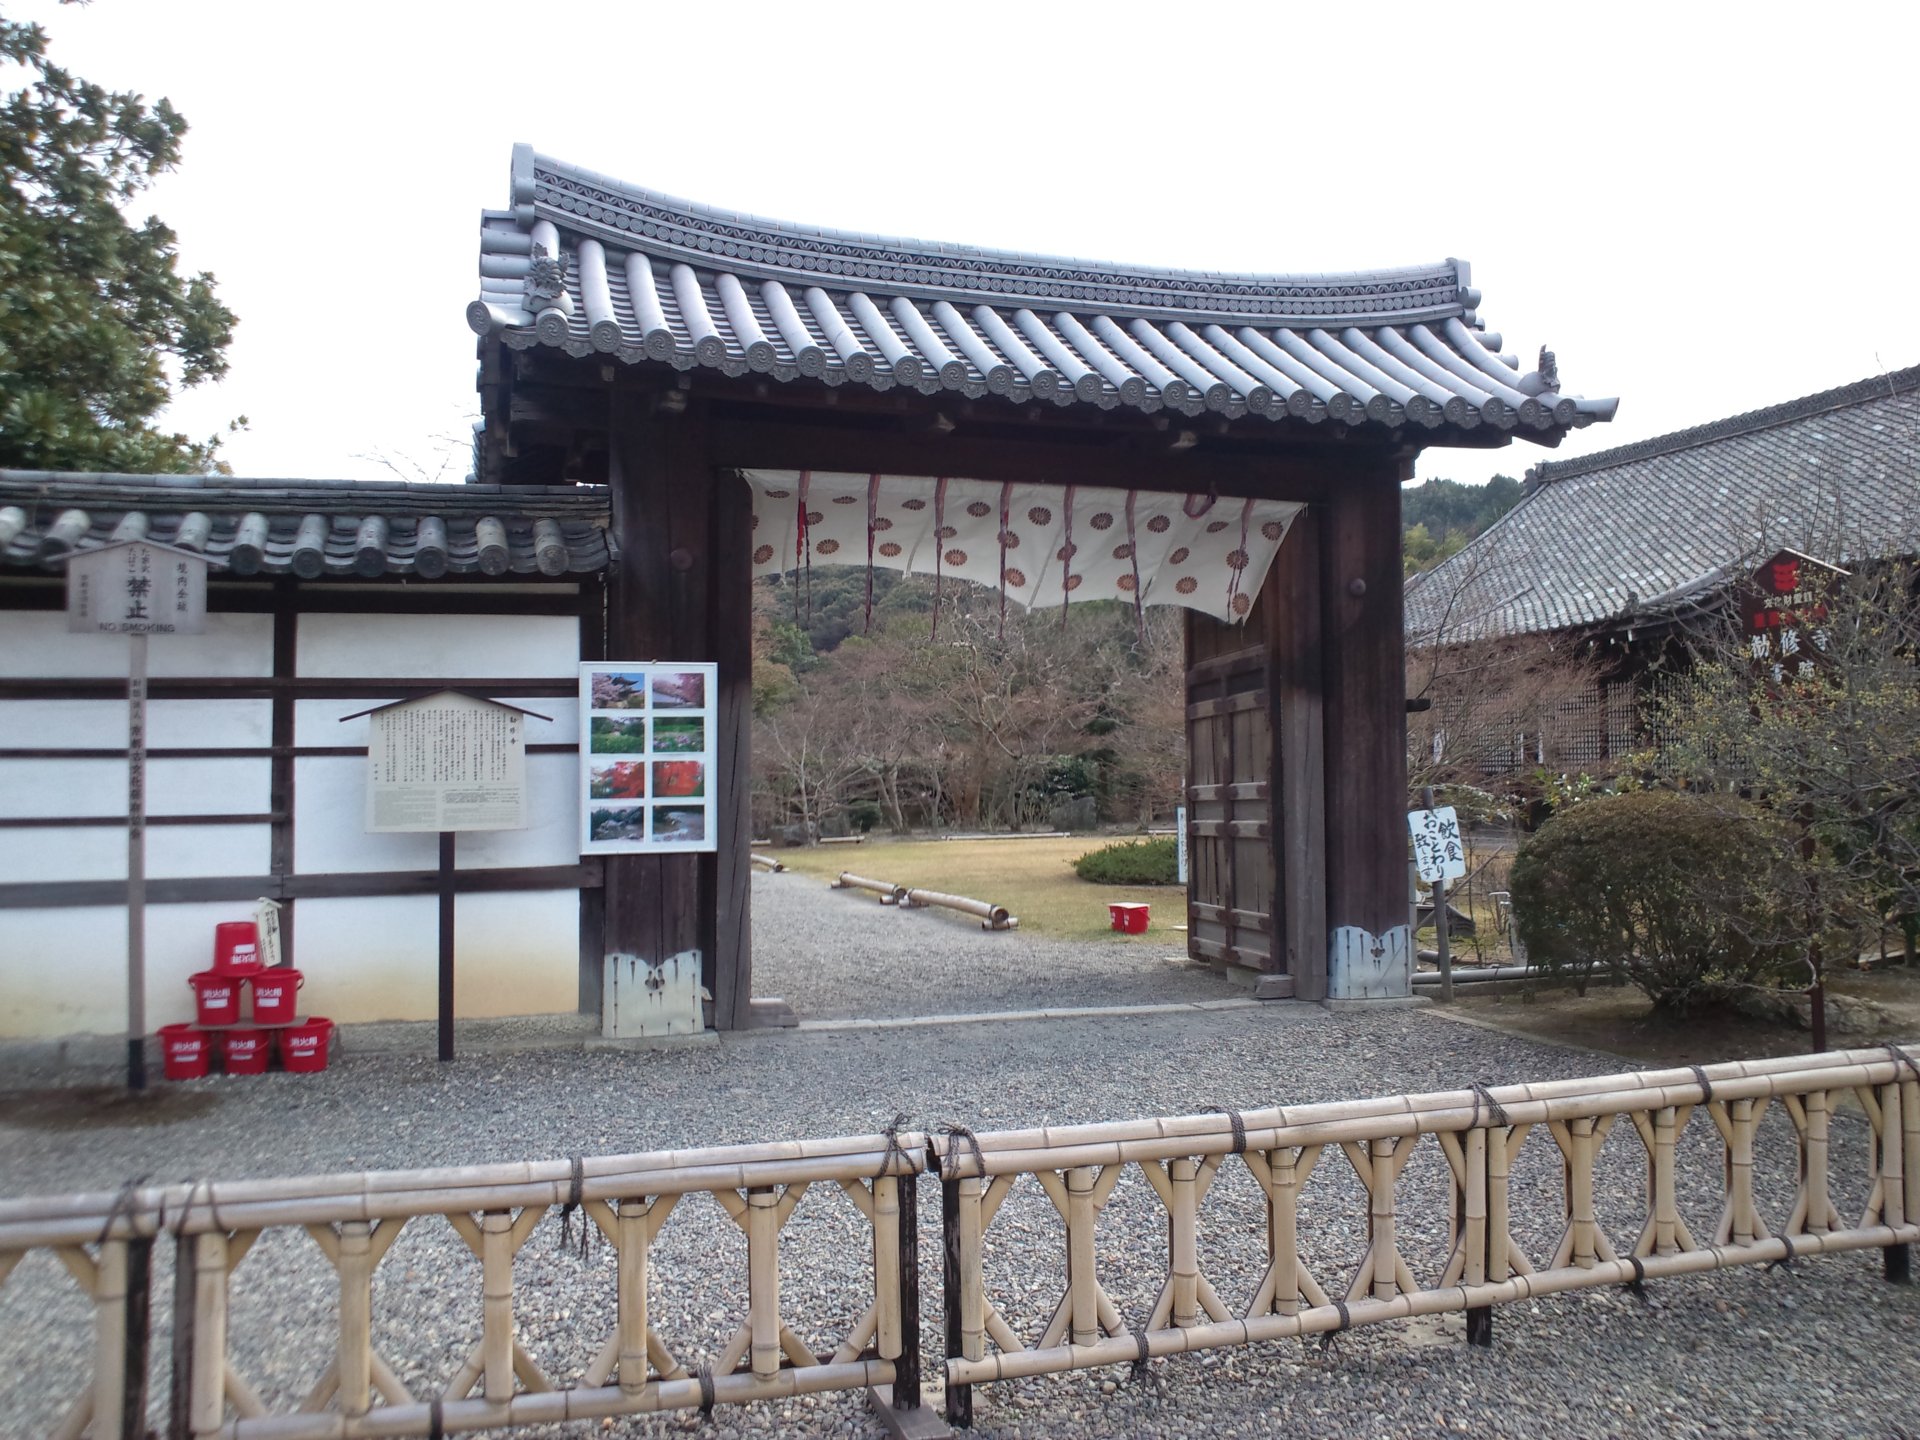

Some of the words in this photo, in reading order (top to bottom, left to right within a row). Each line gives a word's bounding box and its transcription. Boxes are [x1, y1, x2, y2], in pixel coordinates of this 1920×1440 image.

[125, 576, 152, 619] 禁止
[176, 562, 188, 613] 境内全域
[99, 622, 117, 631] NO
[120, 623, 175, 633] SMOKING
[1414, 833, 1433, 880] 致します
[1438, 819, 1463, 862] 飲食
